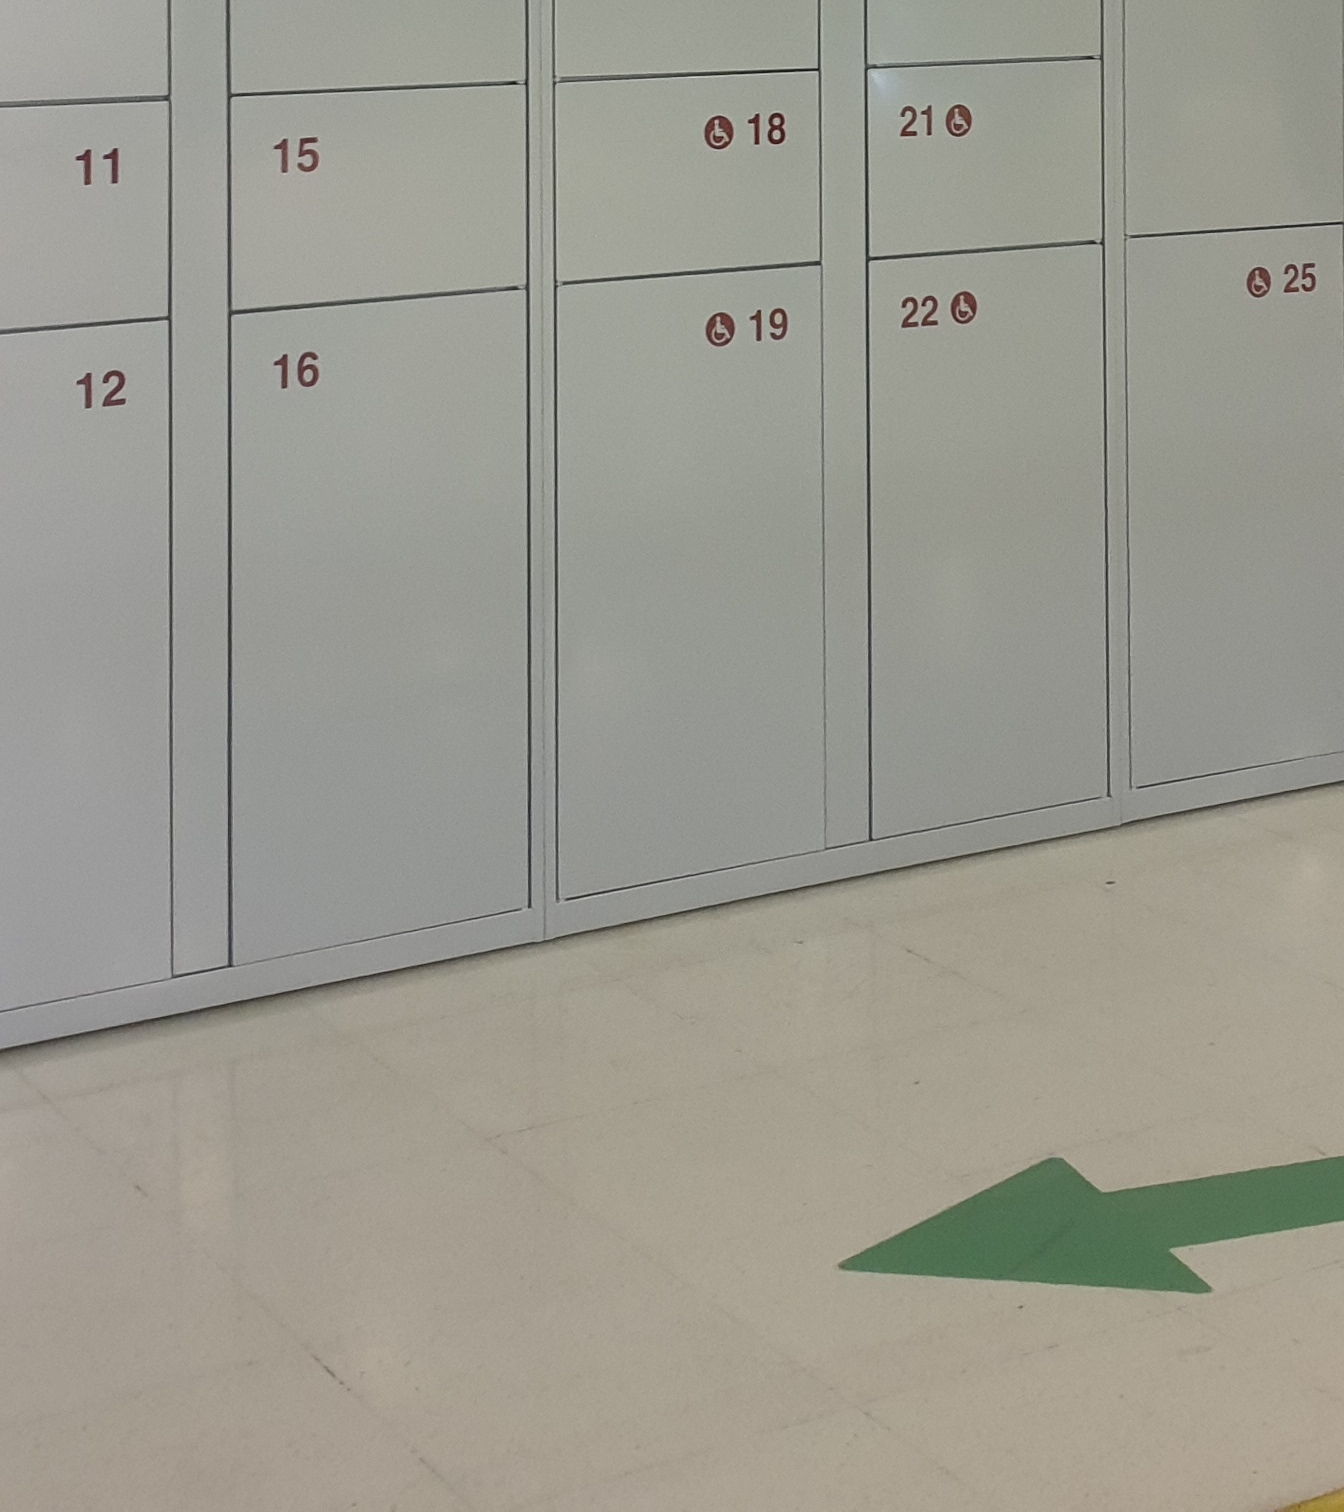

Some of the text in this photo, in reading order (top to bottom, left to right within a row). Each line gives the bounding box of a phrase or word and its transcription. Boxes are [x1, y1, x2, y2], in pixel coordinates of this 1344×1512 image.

[747, 113, 786, 146] 18
[899, 105, 933, 138] 21
[75, 148, 119, 186] 11
[273, 137, 320, 174] 15
[1283, 263, 1317, 294] 25
[749, 308, 789, 342] 19
[901, 296, 939, 329] 22
[273, 352, 320, 390] 16
[76, 370, 127, 409] 12
